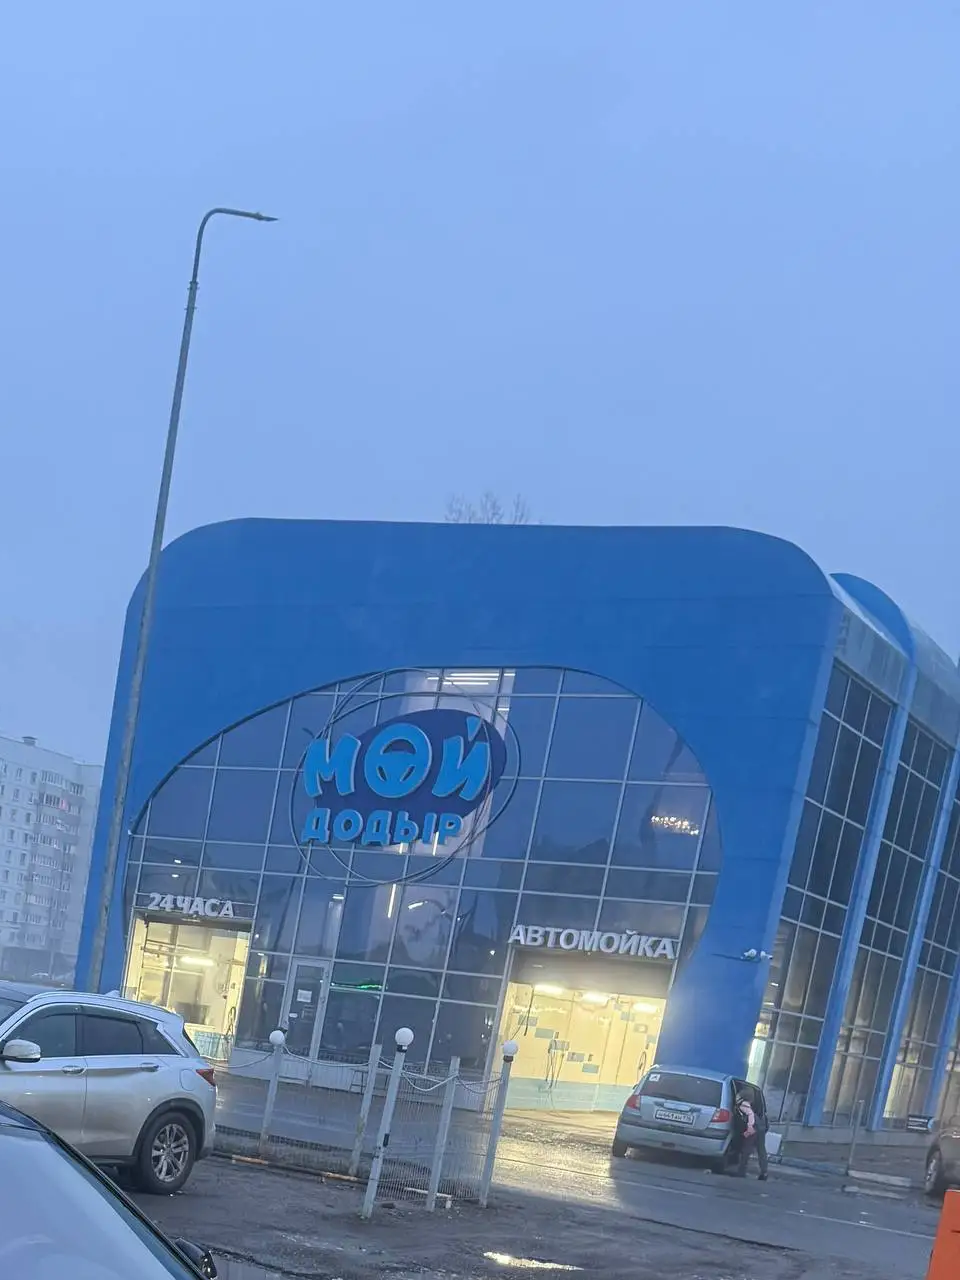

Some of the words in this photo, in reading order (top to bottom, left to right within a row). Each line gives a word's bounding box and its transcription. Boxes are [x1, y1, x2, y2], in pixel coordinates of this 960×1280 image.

[303, 716, 490, 801] МОЙ
[300, 807, 464, 847] ДОДЫР
[147, 892, 175, 912] 24
[176, 895, 235, 919] ЧАСА
[507, 924, 676, 960] АВТОМОЙКА
